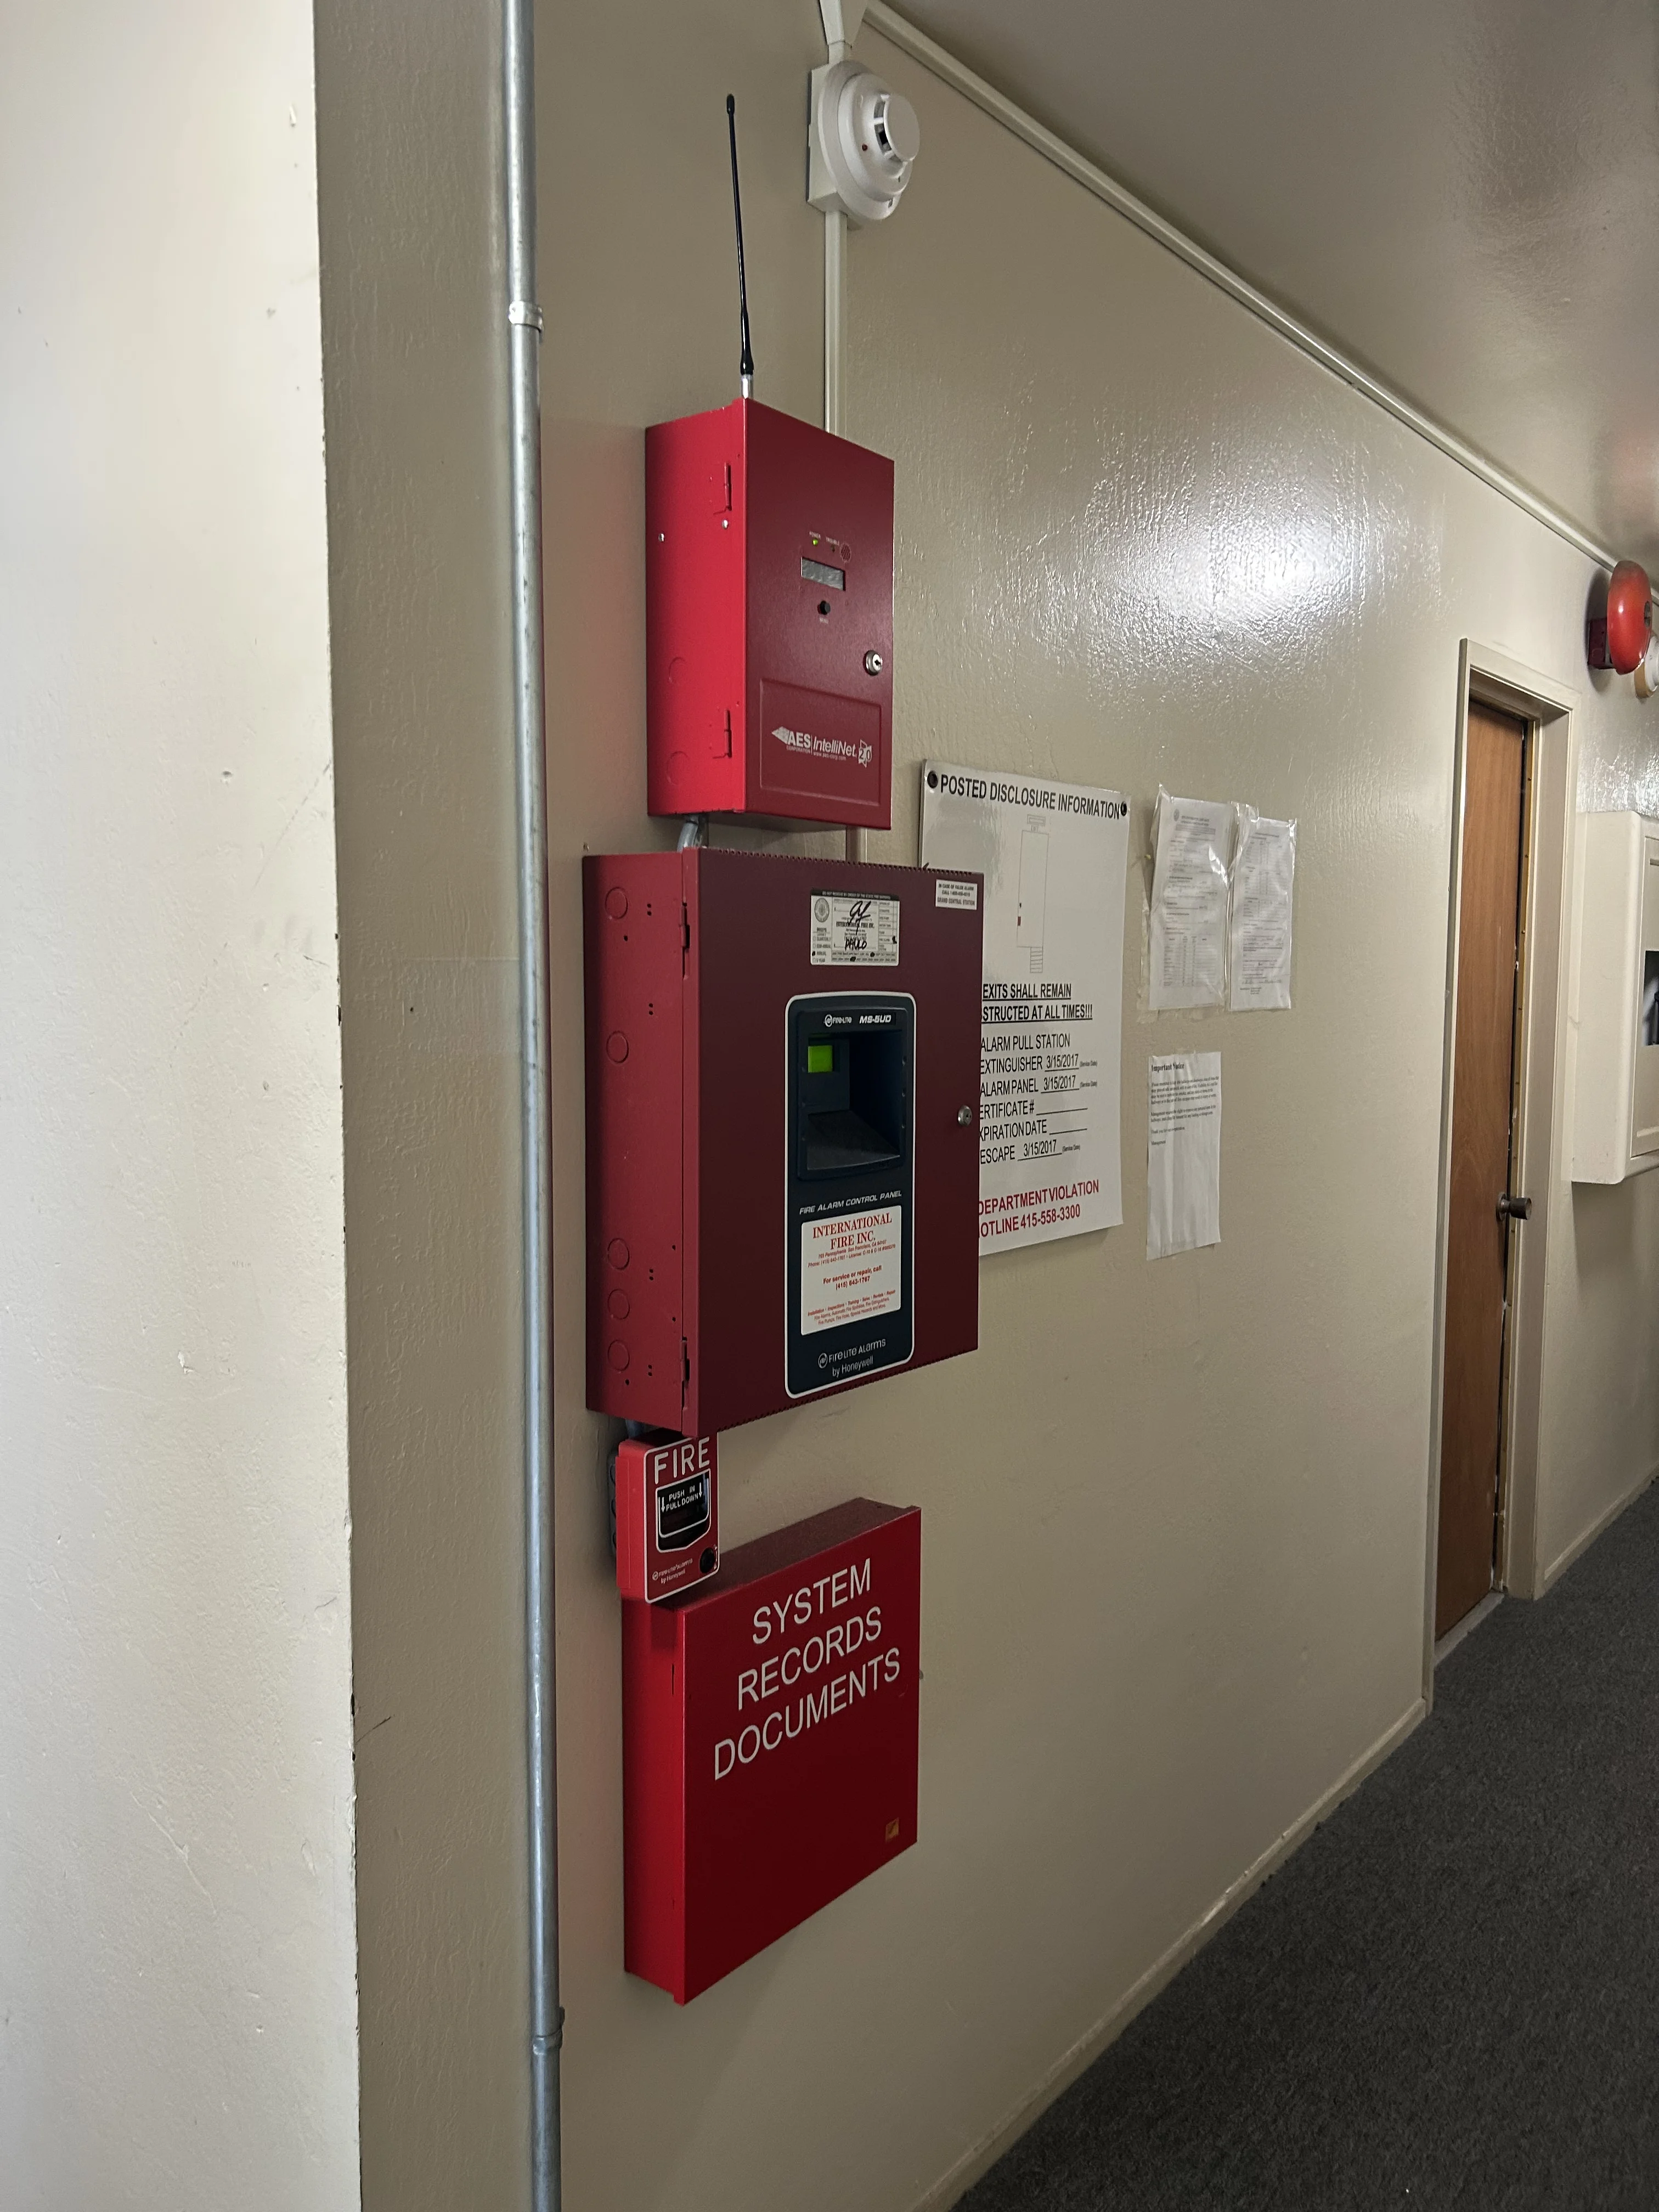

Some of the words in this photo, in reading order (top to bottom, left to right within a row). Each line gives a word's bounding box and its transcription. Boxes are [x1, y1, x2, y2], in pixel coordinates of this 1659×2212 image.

[788, 731, 811, 748] AES
[813, 736, 855, 757] IntelliNet
[940, 774, 986, 799] POSTED
[990, 782, 1056, 810] DISCLOSURE
[1058, 794, 1120, 820] INFORMATION
[983, 984, 1007, 998] EXITS
[1010, 983, 1037, 998] SHALL
[1041, 983, 1071, 997] REMAIN
[983, 1006, 1029, 1021] STRUCTED
[1031, 1005, 1042, 1019] AT
[1045, 1005, 1060, 1019] ALL
[1062, 1004, 1092, 1018] TIMES!!!
[981, 1036, 1010, 1052] ALARM
[1013, 1035, 1033, 1050] PULL
[1036, 1033, 1070, 1049] STATION
[980, 1056, 1042, 1074] EXTINGUISHER
[1046, 1054, 1079, 1069] 3/15/2017
[1152, 1064, 1171, 1073] Important
[980, 1080, 1010, 1097] ALARM
[1012, 1078, 1039, 1094] PANEL
[1044, 1075, 1076, 1090] 3/15/2017
[980, 1100, 1028, 1120] ERTIFICATE
[1030, 1099, 1034, 1114] #
[979, 1121, 1024, 1142] XPIRATION
[1025, 1119, 1047, 1136] DATE
[980, 1146, 1015, 1164] ESCAPE
[1024, 1139, 1057, 1157] 3/15/2017
[799, 1205, 816, 1215] FIRE
[817, 1200, 844, 1212] ALARM
[846, 1195, 878, 1206] CONTROL
[879, 1190, 902, 1200] PANEL
[979, 1189, 1048, 1215] DEPARTMENT
[1049, 1179, 1099, 1202] VIOLATION
[812, 1212, 892, 1239] INTERNATIONAL
[979, 1216, 1019, 1238] OTLINE
[1020, 1204, 1080, 1228] 415-558-3300
[831, 1234, 854, 1250] FIRE
[857, 1231, 876, 1245] INC.
[832, 1273, 850, 1282] service
[832, 1367, 840, 1378] by
[842, 1355, 873, 1374] Honeywell
[654, 1436, 710, 1485] FIRE
[666, 1500, 681, 1512] PULL
[682, 1494, 699, 1506] DOWN
[669, 1489, 685, 1501] PUSH
[690, 1485, 696, 1493] IN
[753, 1558, 871, 1644] SYSTEM
[738, 1606, 882, 1711] RECORDS
[715, 1647, 900, 1781] DOCUMENTS
